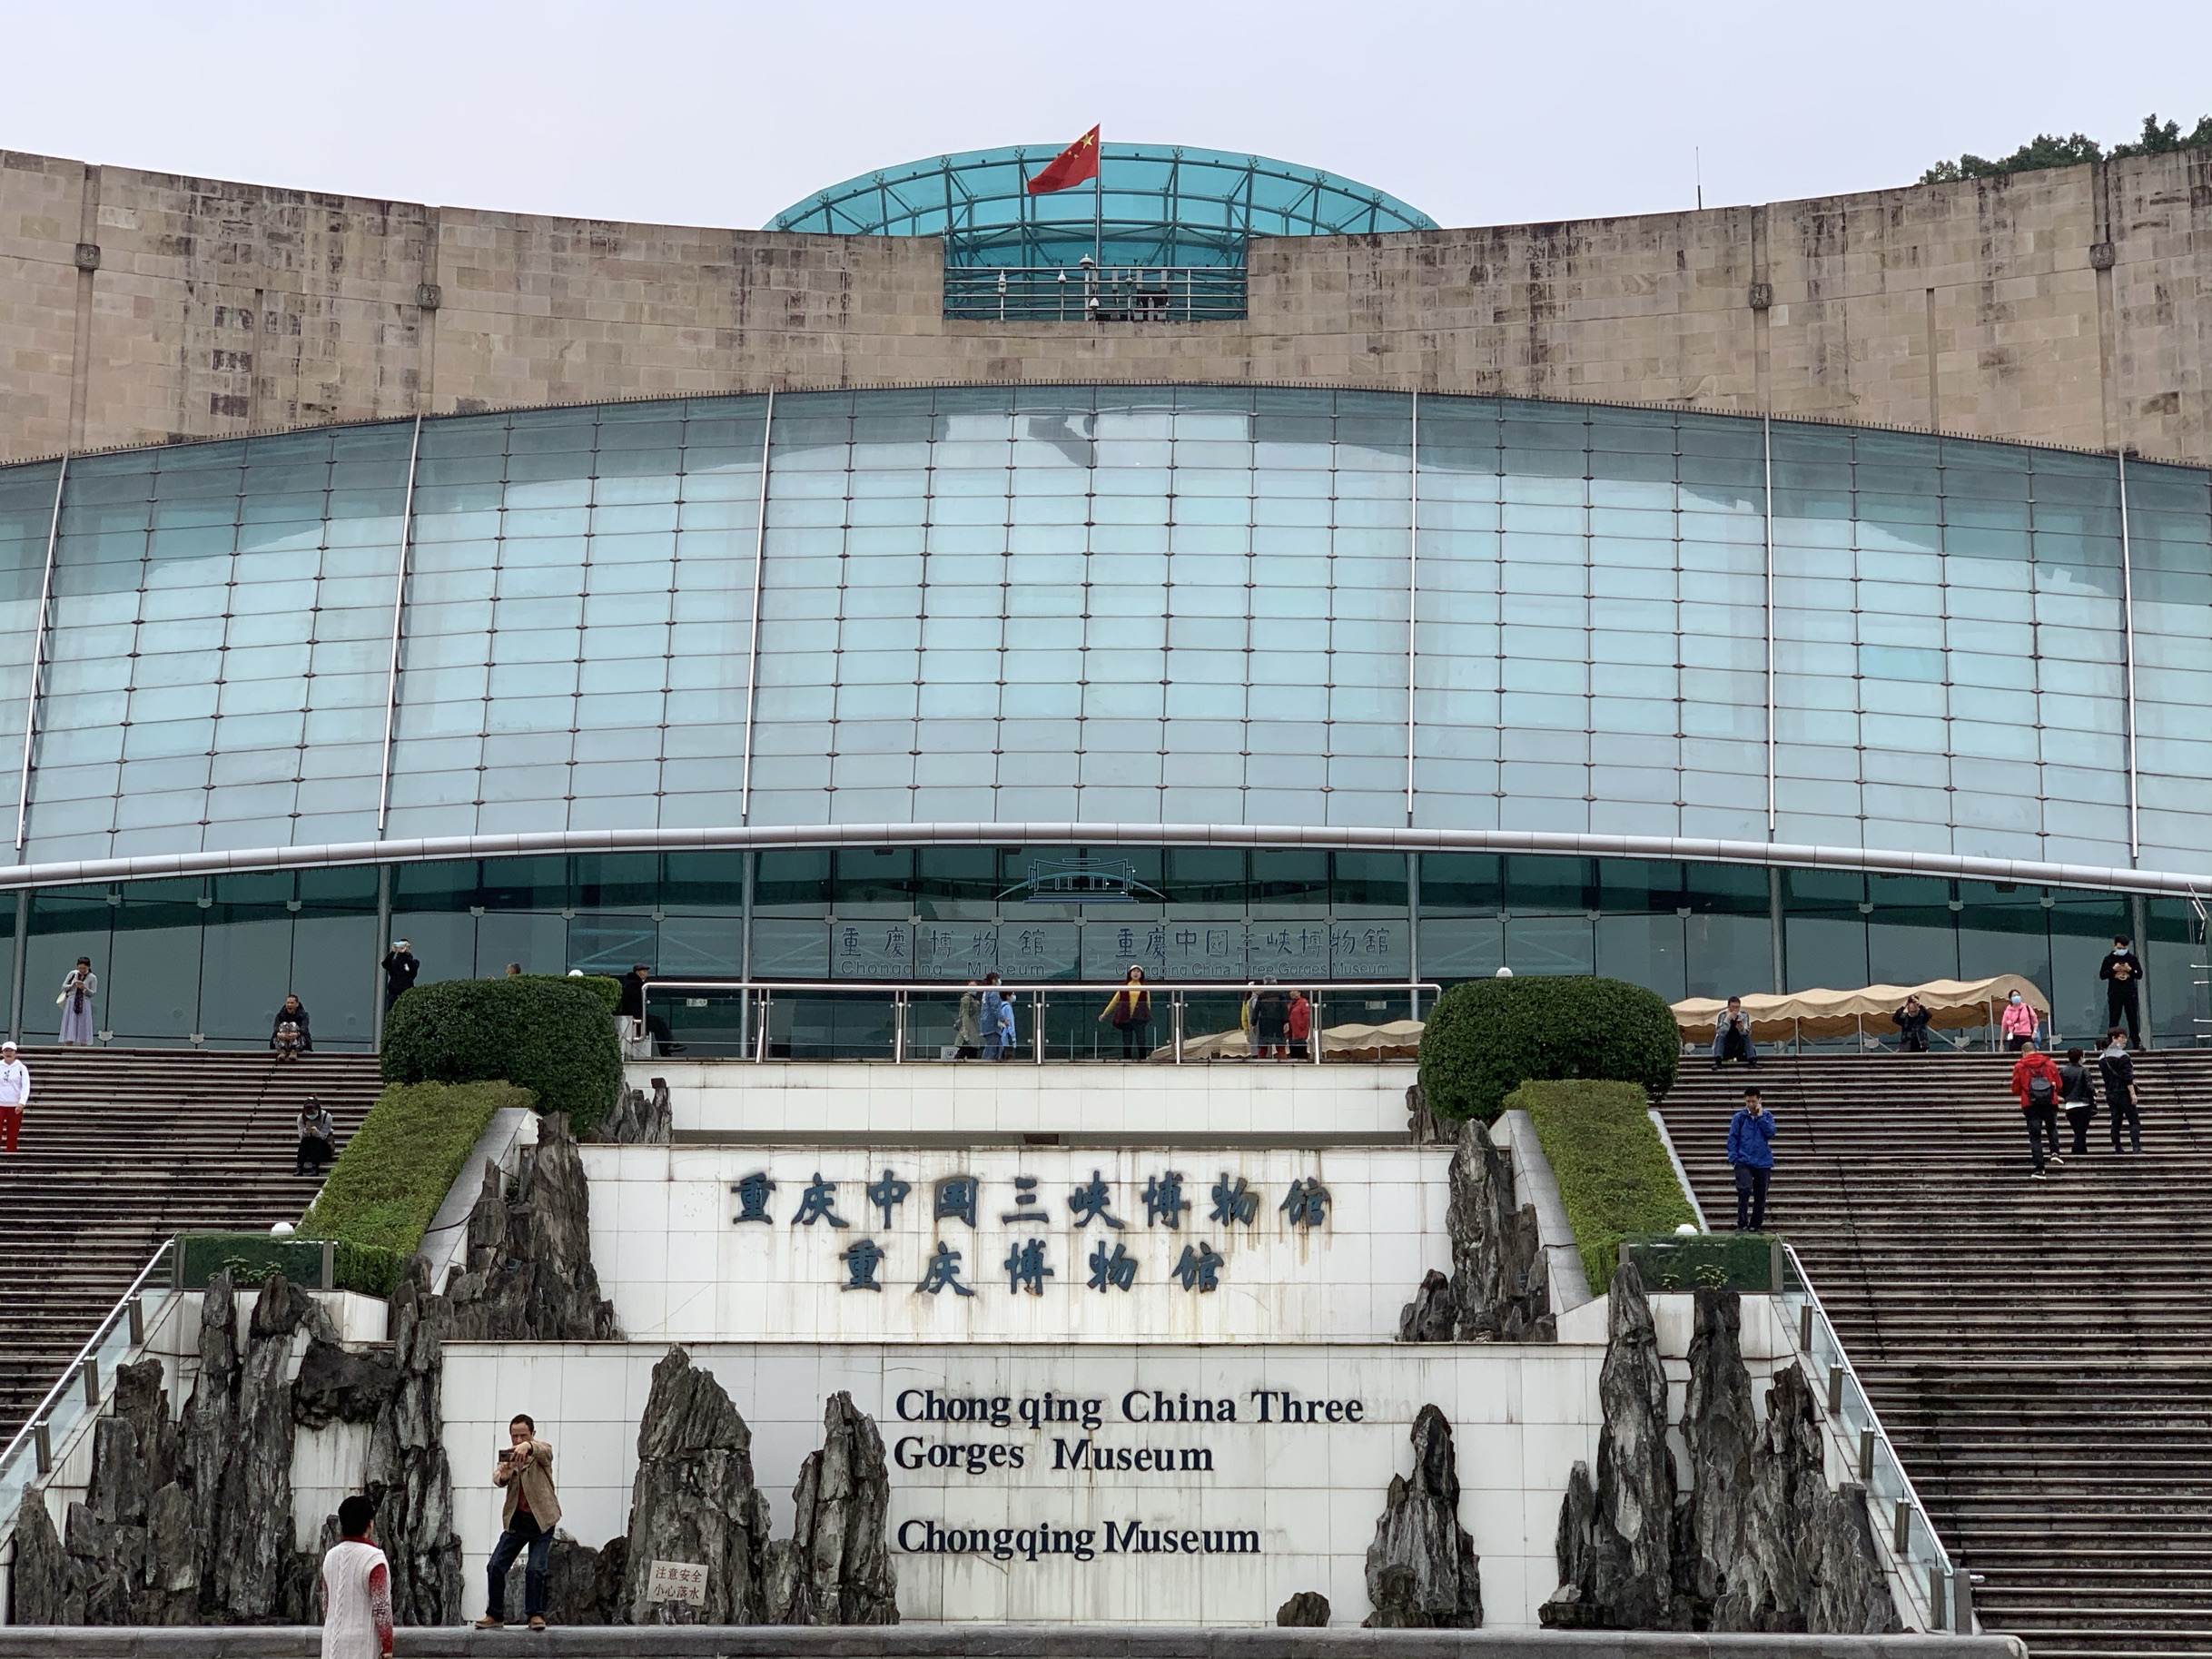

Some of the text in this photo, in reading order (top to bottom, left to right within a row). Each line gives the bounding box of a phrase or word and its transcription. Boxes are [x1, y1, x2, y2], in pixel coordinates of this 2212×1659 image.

[841, 960, 1045, 980] Chongqing Museum
[1115, 962, 1390, 980] Cngqing China Three Gorges Museum
[729, 1169, 1333, 1232] 重庆中国三峡博物馆
[838, 1238, 1225, 1298] 重庆博物馆
[1121, 1388, 1237, 1423] China
[1250, 1388, 1364, 1423] Three
[894, 1436, 1214, 1476] Gorges Museum
[897, 1519, 1261, 1562] Chongqing Museum
[654, 1584, 699, 1599] 小心落水
[656, 1566, 702, 1583] 注意安全
